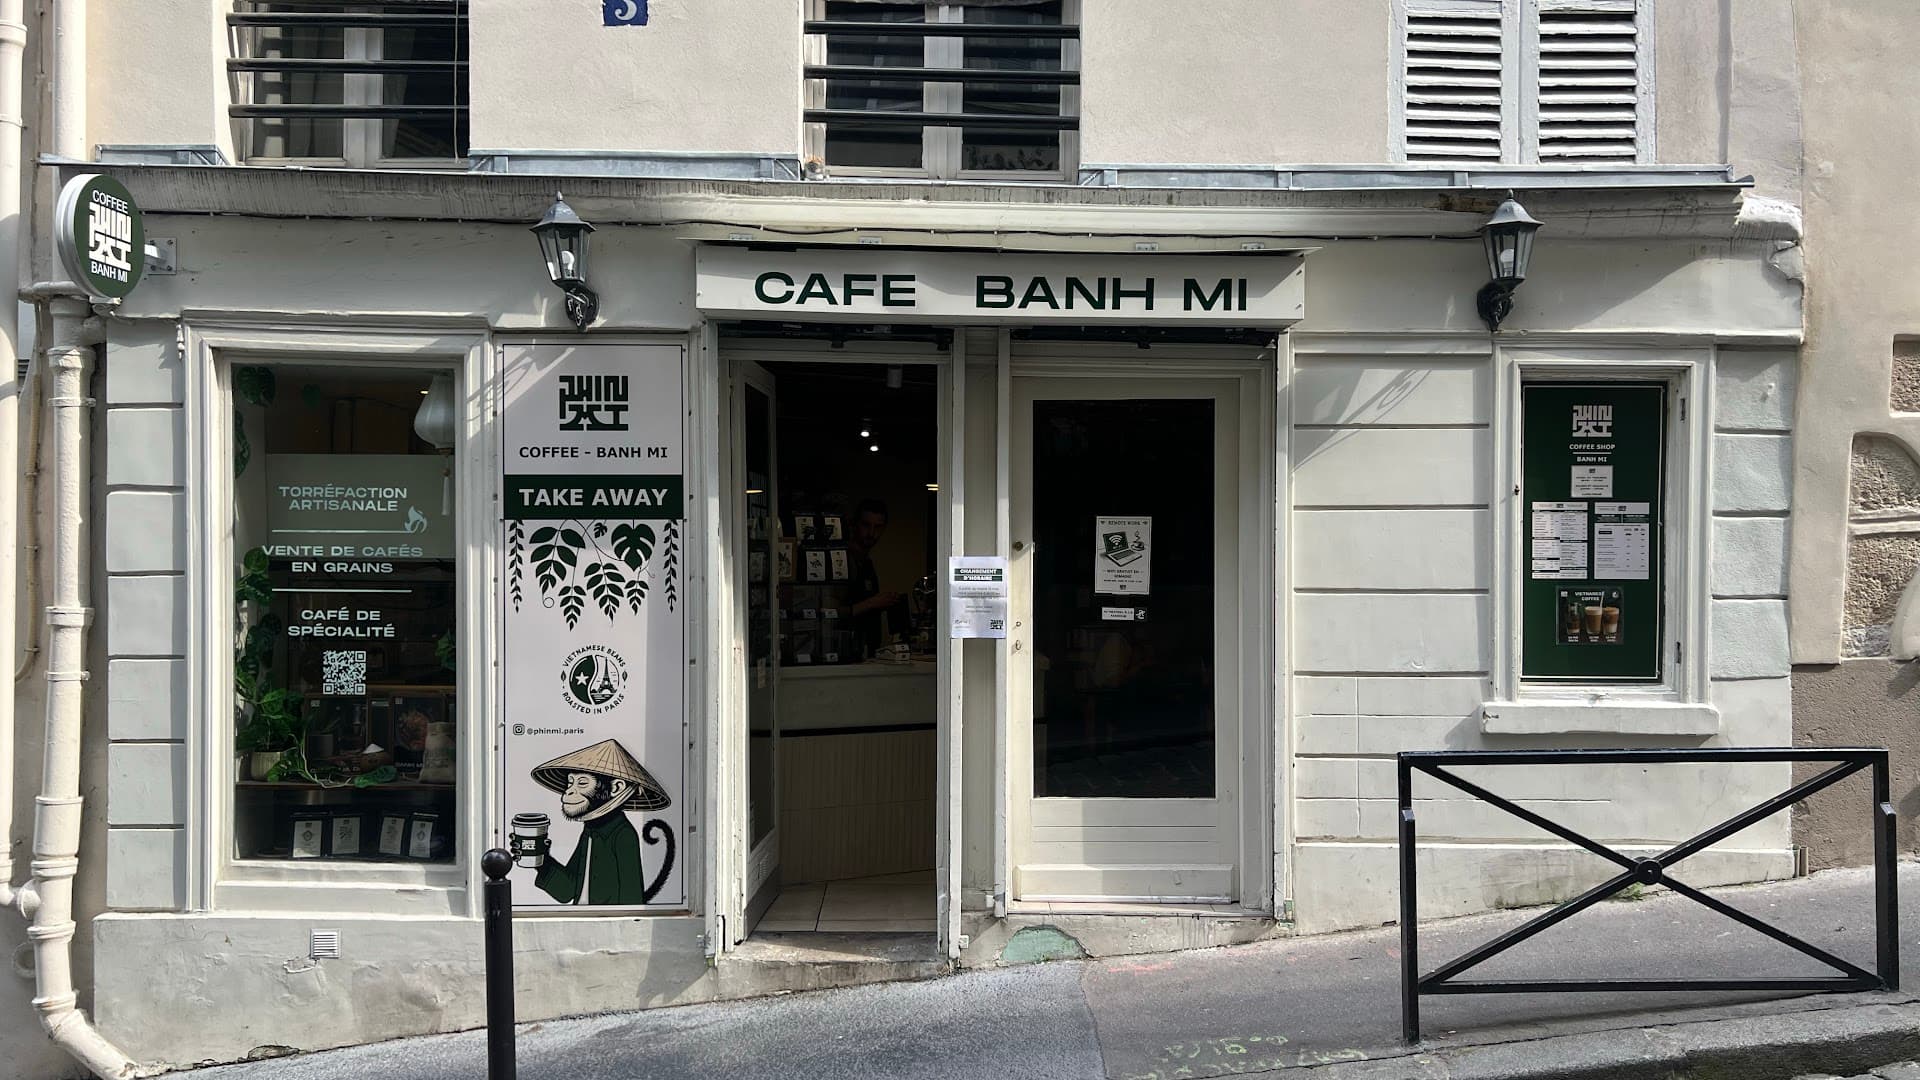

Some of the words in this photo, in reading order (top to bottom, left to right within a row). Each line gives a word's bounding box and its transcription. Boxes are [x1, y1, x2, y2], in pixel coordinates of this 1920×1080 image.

[92, 190, 128, 213] COFFEE
[91, 262, 116, 280] BANH
[117, 271, 128, 283] MI
[754, 271, 917, 307] CAFE
[975, 275, 1155, 311] BANH
[1183, 278, 1248, 312] MI
[519, 446, 579, 459] COFFEE
[596, 447, 641, 459] BANH
[647, 447, 668, 459] MI
[1569, 443, 1595, 451] COFFEE
[279, 483, 407, 498] TORRÉFACTION
[518, 488, 584, 507] TAKE
[591, 488, 669, 507] AWAY
[288, 499, 399, 512] ARTISANALE
[262, 545, 324, 557] VENTE
[331, 546, 355, 557] DE
[361, 544, 424, 557] CAFÉS
[291, 562, 317, 573] EN
[323, 562, 394, 574] GRAINS
[301, 607, 350, 621] CAFÉ
[356, 610, 381, 621] DE
[287, 623, 396, 638] SPÉCIALITÉ
[562, 644, 606, 668] VIETNAMESE
[606, 648, 627, 668] BEANS
[562, 691, 591, 714] ROASTED
[604, 693, 625, 713] PARIS
[526, 727, 585, 736] @phinmi.paris
